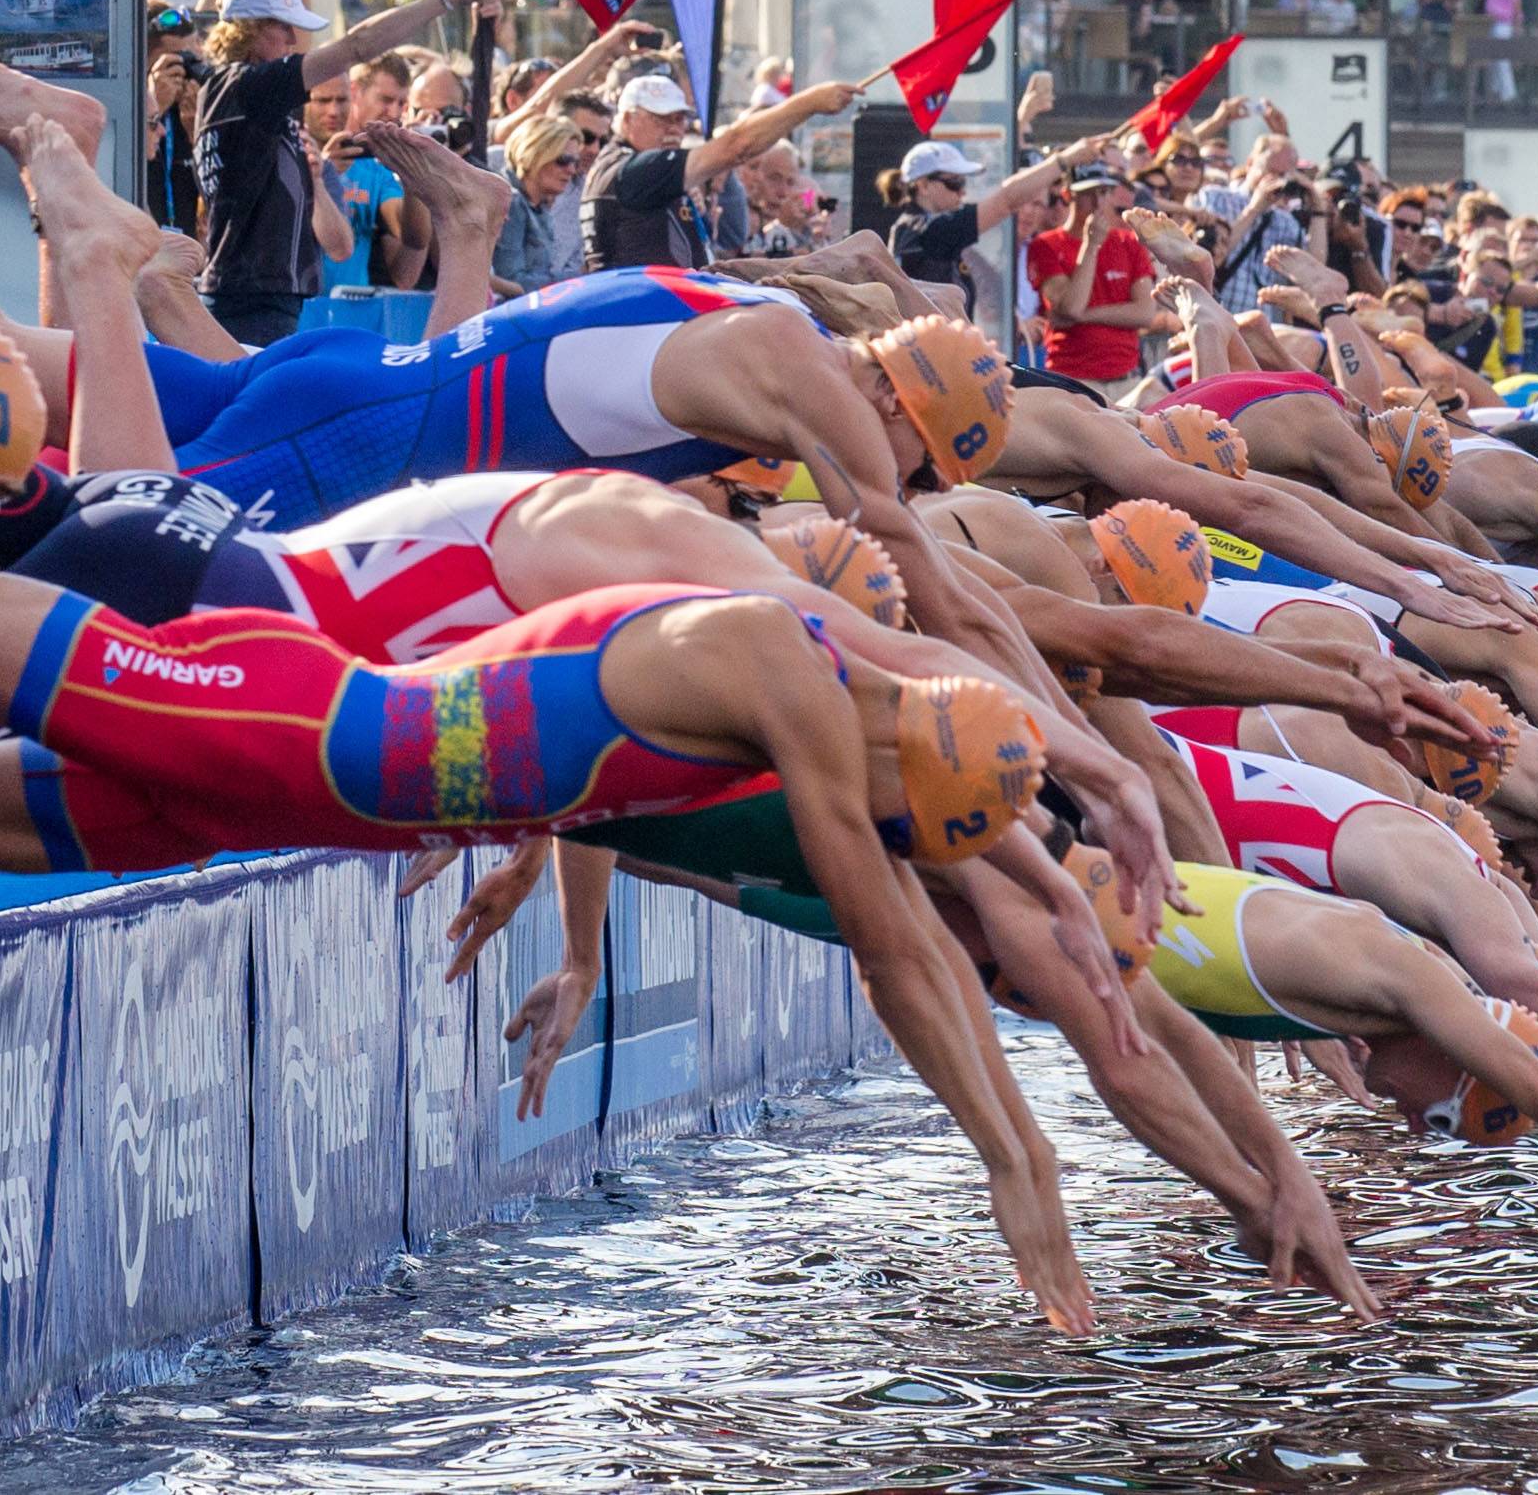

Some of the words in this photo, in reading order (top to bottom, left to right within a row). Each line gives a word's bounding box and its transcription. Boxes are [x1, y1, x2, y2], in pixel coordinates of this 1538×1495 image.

[953, 422, 988, 460] 8
[1406, 457, 1440, 496] 29
[1209, 537, 1250, 557] MAVIC
[104, 640, 245, 688] GARMIN
[944, 810, 988, 846] 2
